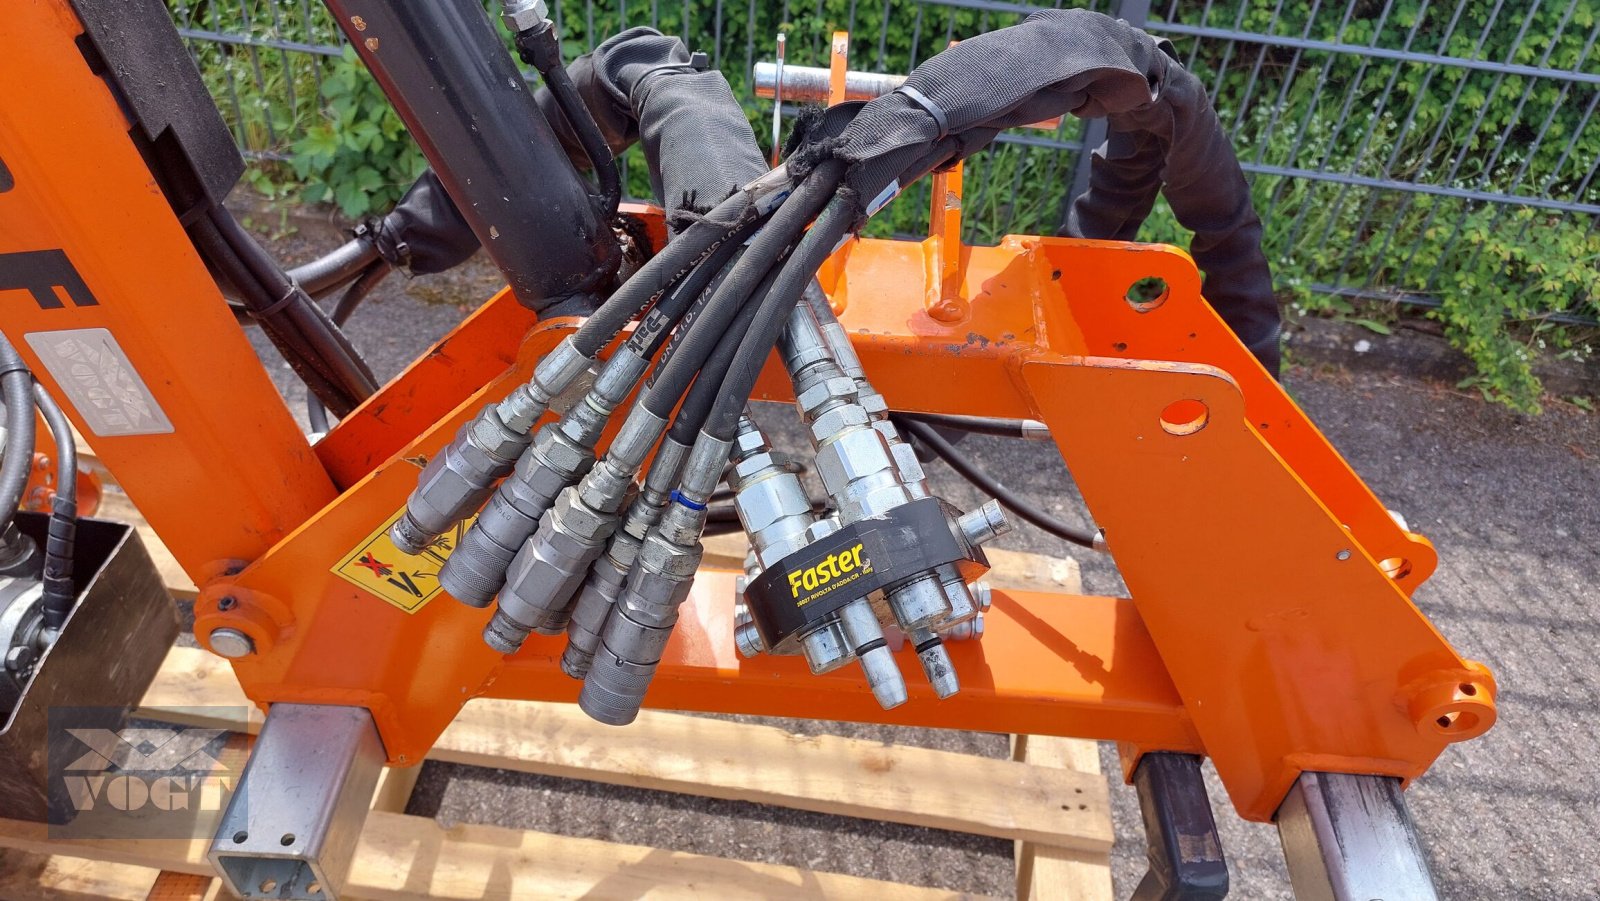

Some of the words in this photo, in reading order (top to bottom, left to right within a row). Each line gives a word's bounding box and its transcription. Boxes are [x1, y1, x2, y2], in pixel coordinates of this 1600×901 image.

[660, 341, 674, 364] DN
[53, 338, 136, 428] VOGT
[787, 543, 863, 598] Faster
[811, 587, 832, 600] RIVOLTA
